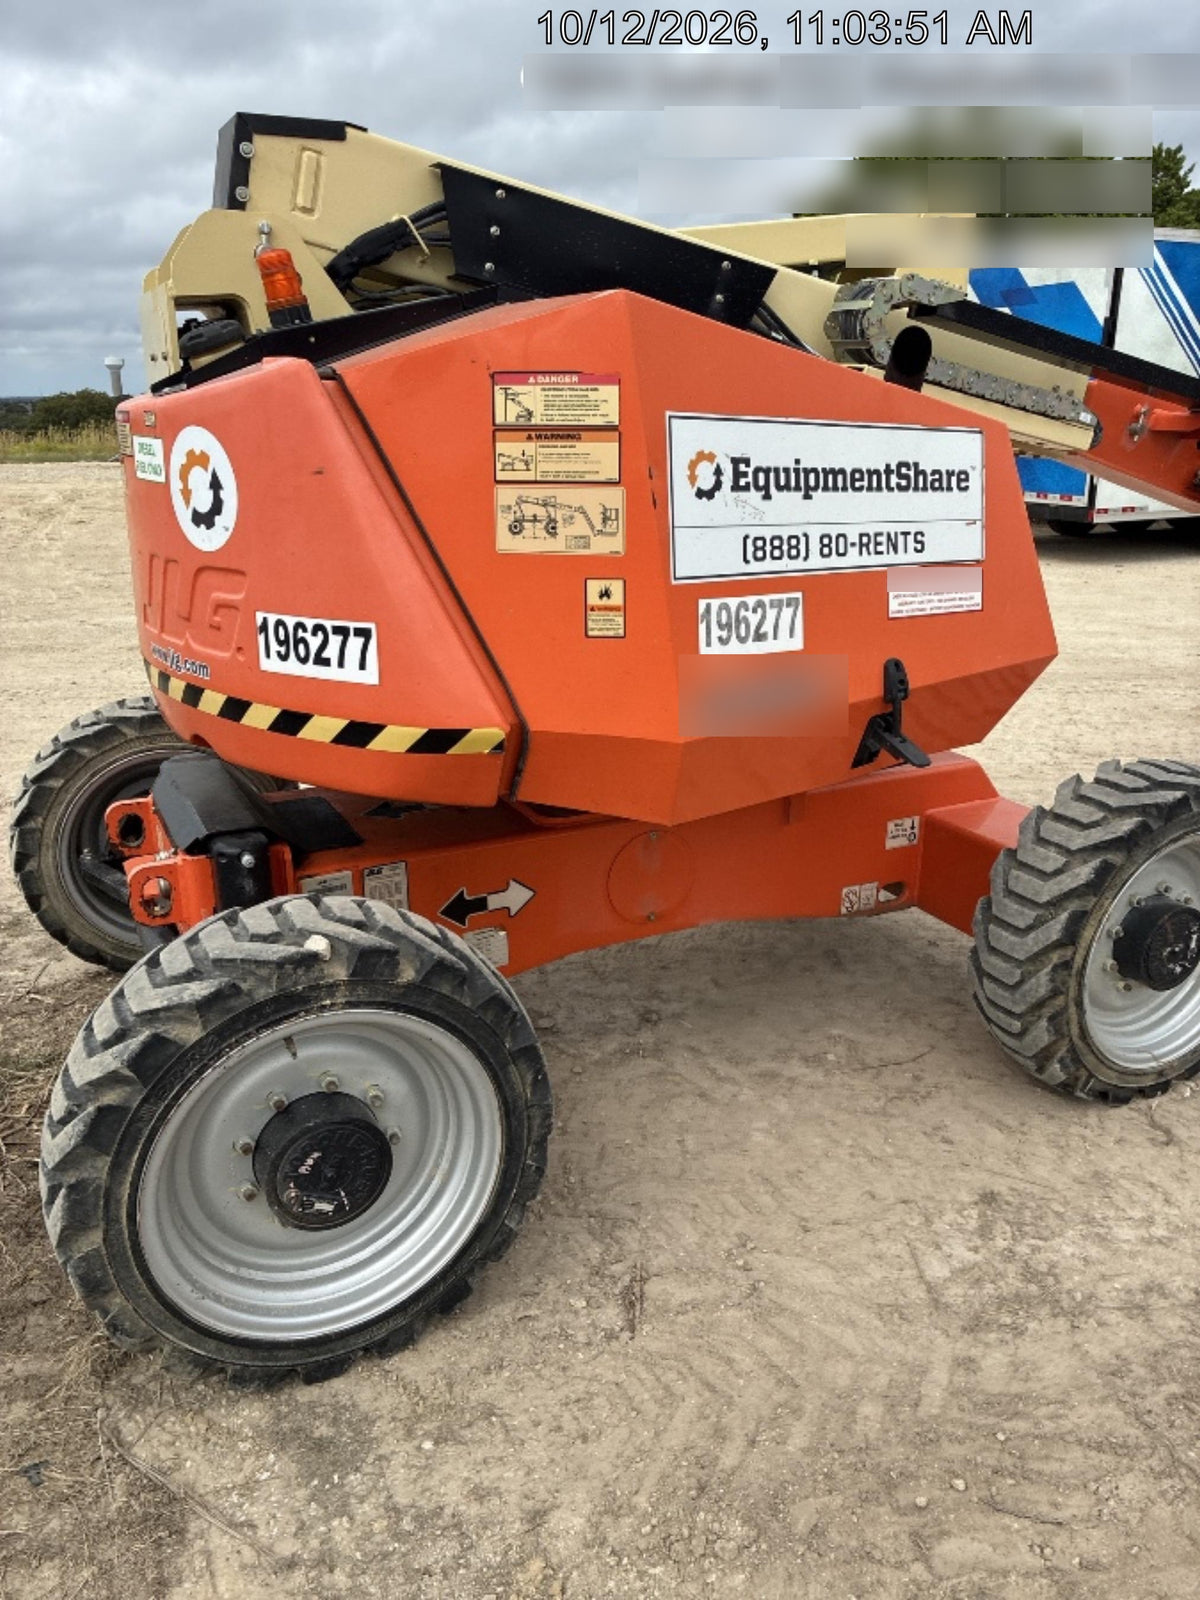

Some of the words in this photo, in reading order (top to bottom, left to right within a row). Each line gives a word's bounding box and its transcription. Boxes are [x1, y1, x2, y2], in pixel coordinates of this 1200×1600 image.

[536, 375, 579, 383] DANGER
[534, 433, 582, 441] WARNING
[730, 456, 970, 500] EquipmentShare
[742, 532, 809, 564] (888)
[819, 531, 925, 559] 80-RENTS
[699, 597, 801, 647] 196277
[258, 616, 372, 671] 196277
